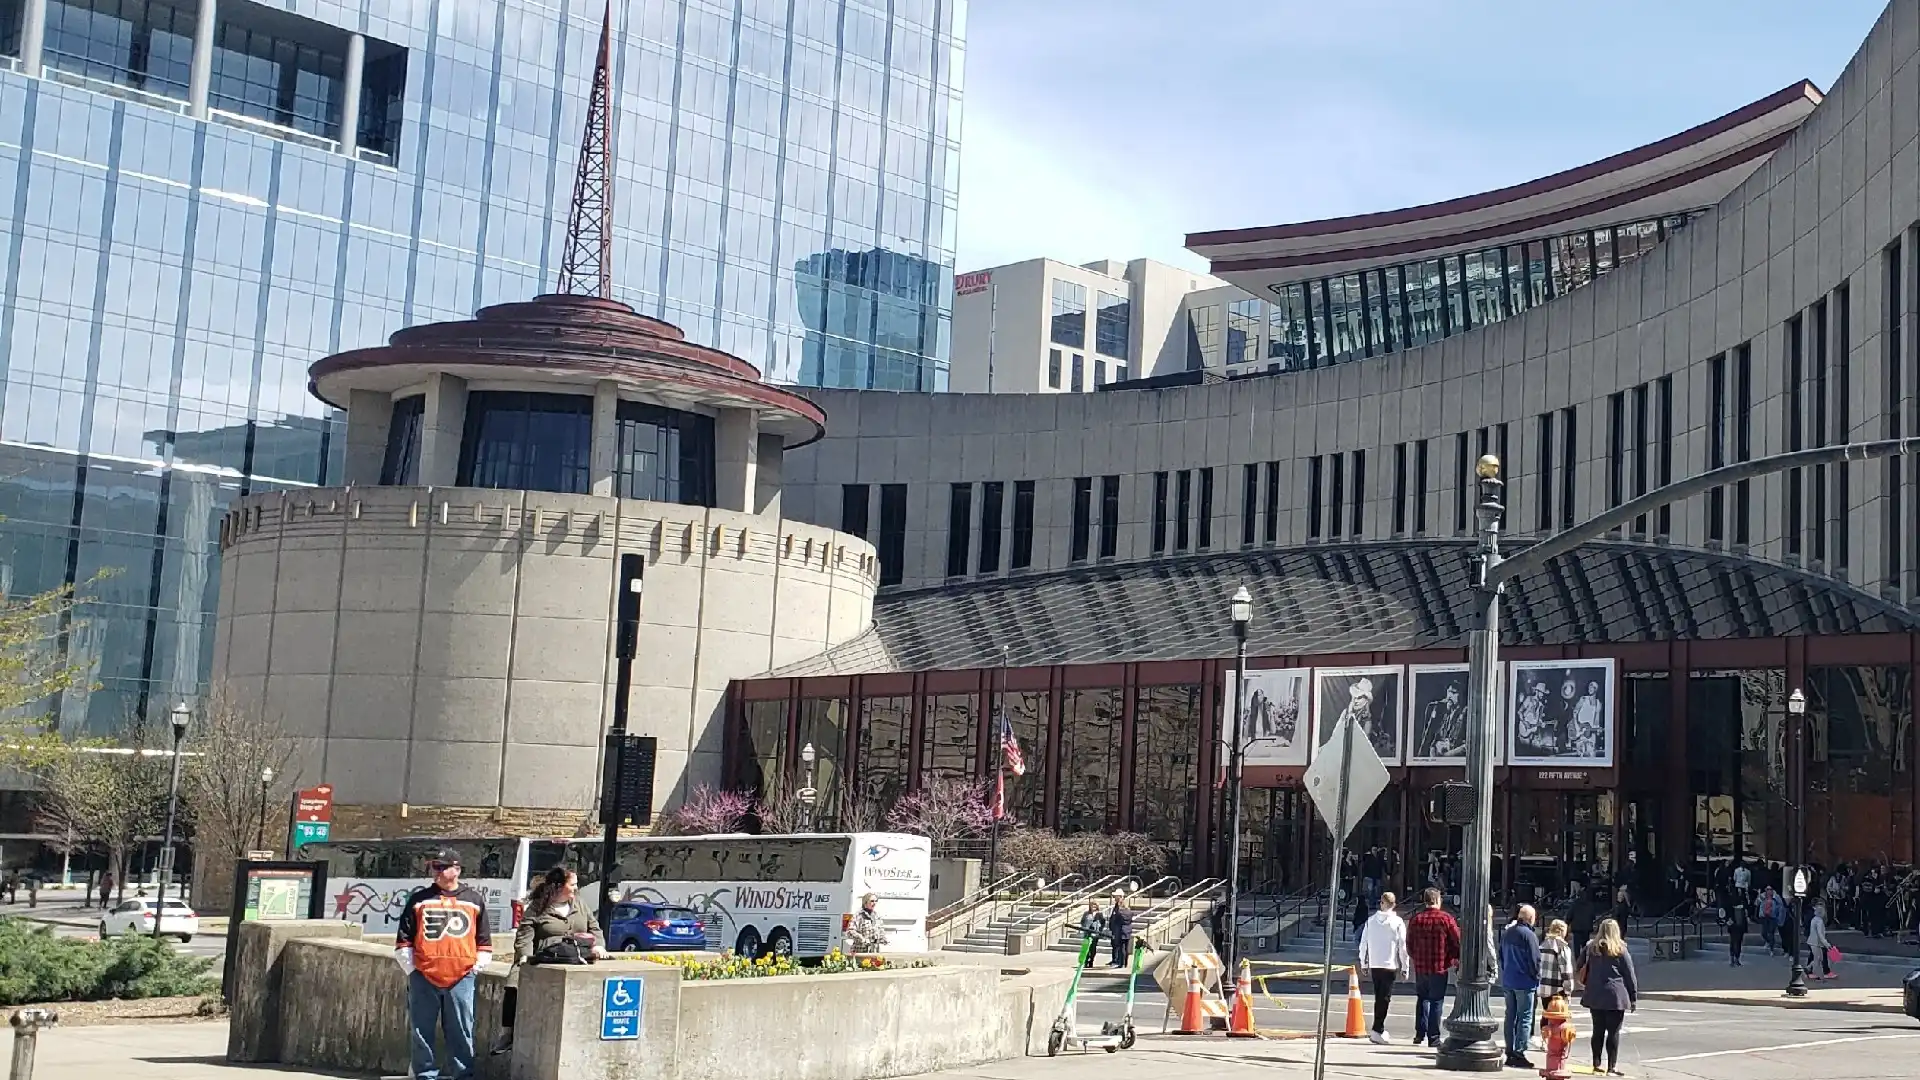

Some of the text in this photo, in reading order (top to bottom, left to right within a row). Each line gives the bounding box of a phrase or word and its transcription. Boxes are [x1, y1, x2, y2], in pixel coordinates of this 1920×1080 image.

[955, 271, 992, 290] DRURY
[1548, 771, 1563, 779] FIFTH
[612, 1017, 630, 1025] ROUTE
